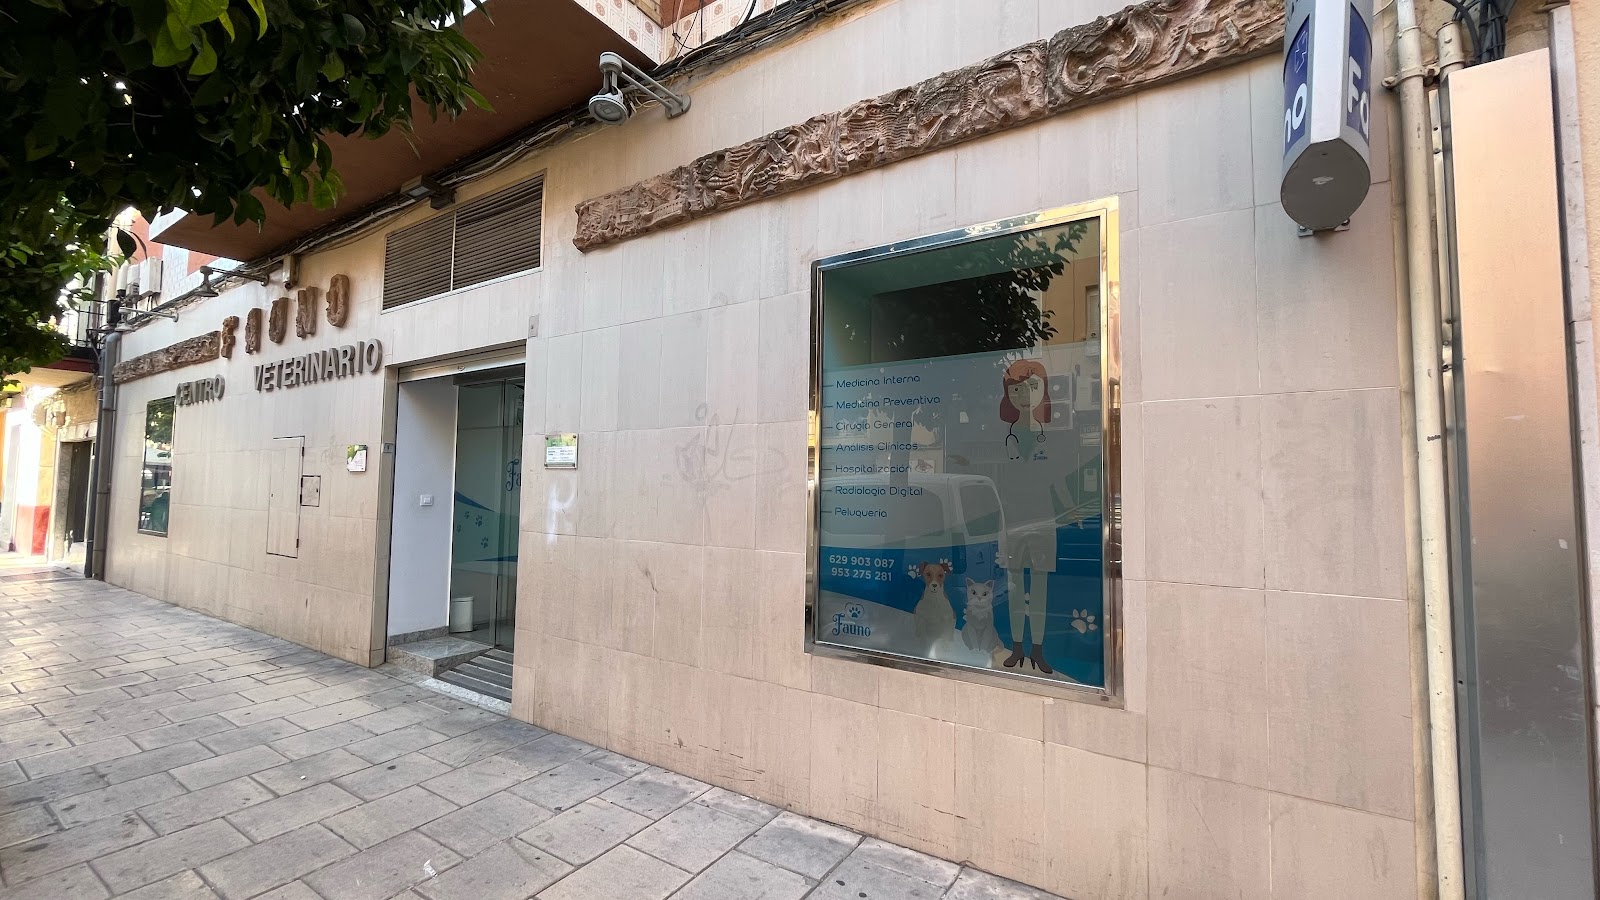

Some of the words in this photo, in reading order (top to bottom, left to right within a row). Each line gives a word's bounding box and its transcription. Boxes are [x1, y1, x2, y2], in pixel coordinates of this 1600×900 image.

[221, 273, 350, 359] FAUNO
[176, 374, 226, 407] CENTRO
[254, 338, 383, 392] VETERINARIO
[836, 379, 880, 389] Medicina
[883, 375, 921, 385] Interna
[836, 400, 880, 409] Medicina
[883, 395, 941, 407] Preventiva
[873, 419, 915, 429] General
[835, 464, 912, 474] Hospitalización
[889, 486, 923, 497] Digital
[834, 507, 888, 518] Peluquería
[829, 555, 848, 565] 629
[851, 556, 871, 567] 903
[874, 558, 895, 569] 087
[831, 567, 850, 578] 953
[852, 569, 872, 580] 275
[874, 571, 892, 582] 281
[832, 612, 872, 637] Fauno
